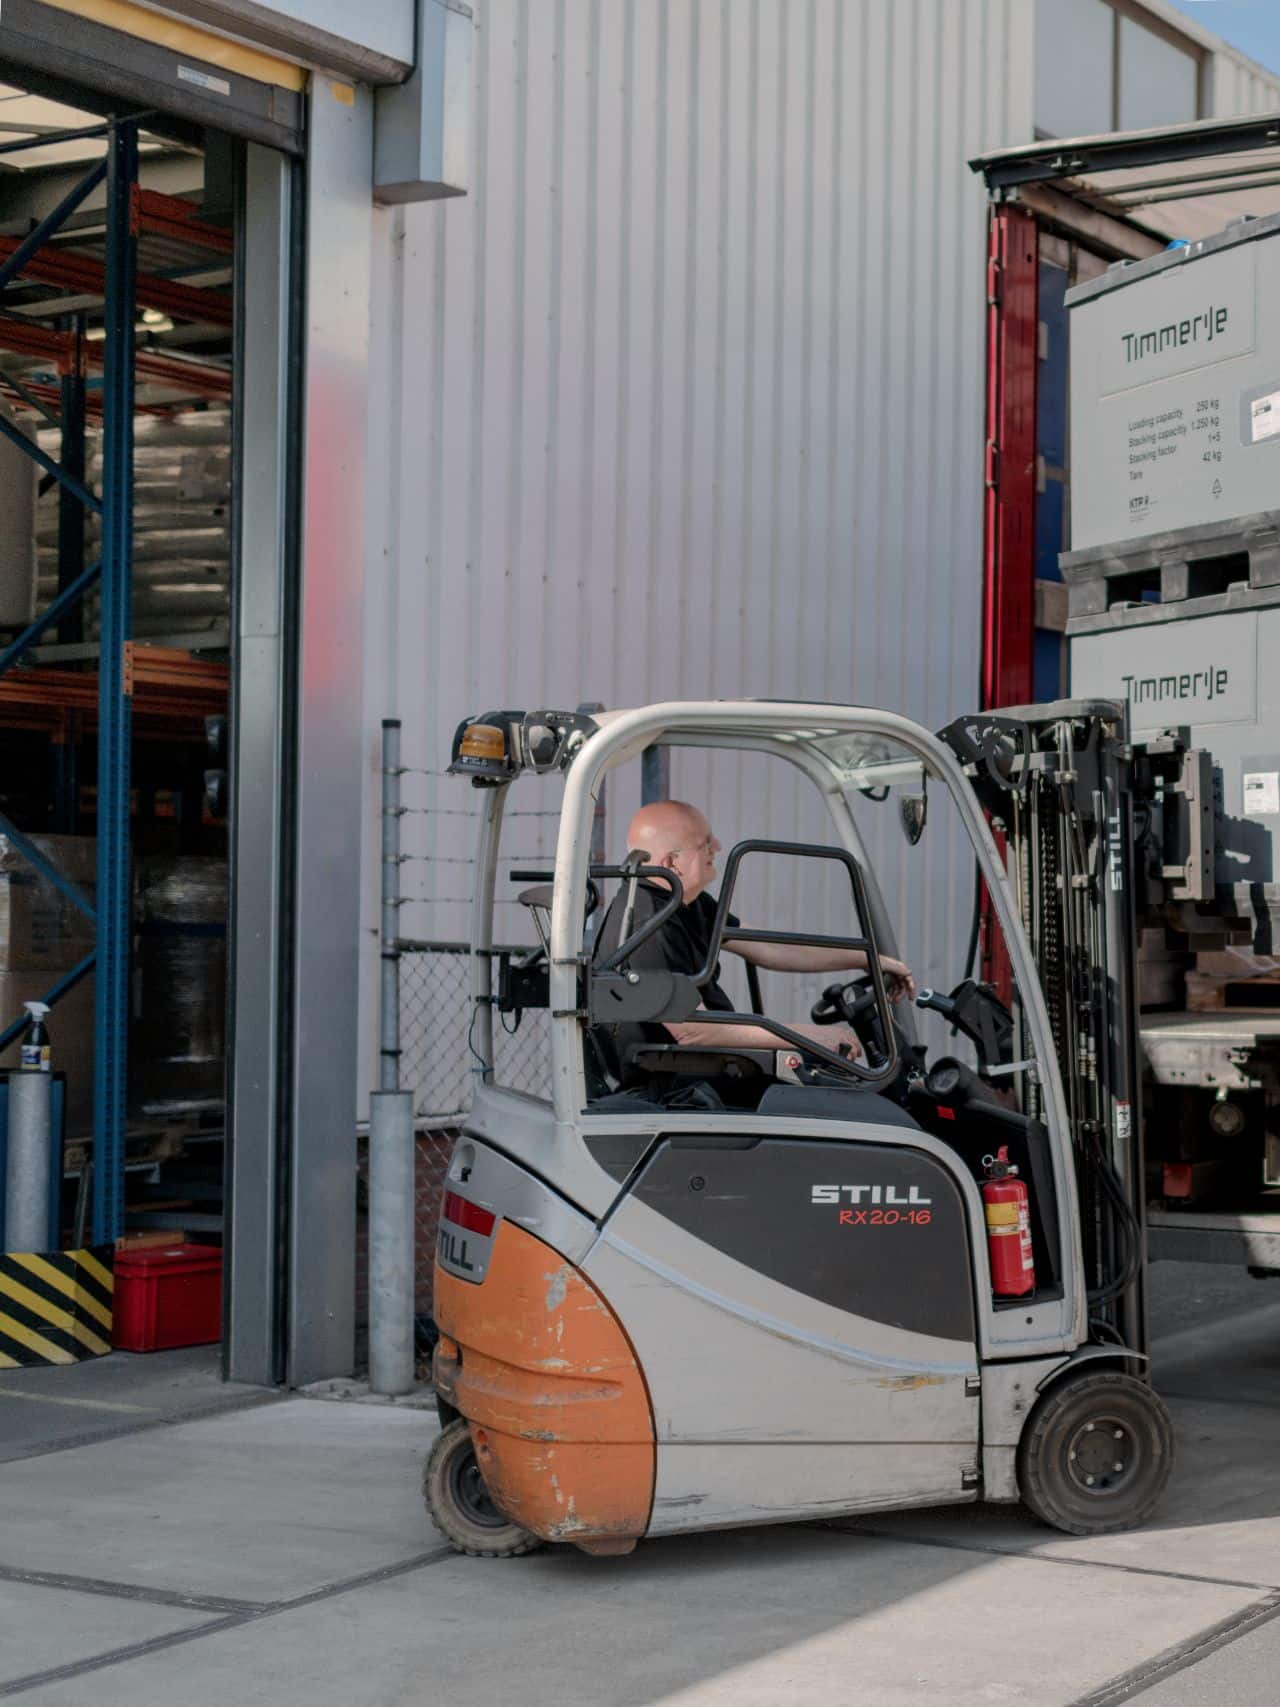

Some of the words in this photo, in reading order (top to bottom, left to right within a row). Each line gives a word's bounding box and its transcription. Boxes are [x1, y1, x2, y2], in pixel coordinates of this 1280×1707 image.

[1129, 417, 1154, 431] Loading
[1156, 409, 1183, 423] capacity
[1210, 400, 1220, 410] kg
[1129, 433, 1157, 447] Stacking
[1210, 416, 1220, 427] kg
[1129, 450, 1157, 464] Stacking
[1158, 445, 1177, 456] factor
[1212, 451, 1222, 462] kg
[1108, 807, 1123, 890] STILL
[811, 1184, 932, 1204] STILL
